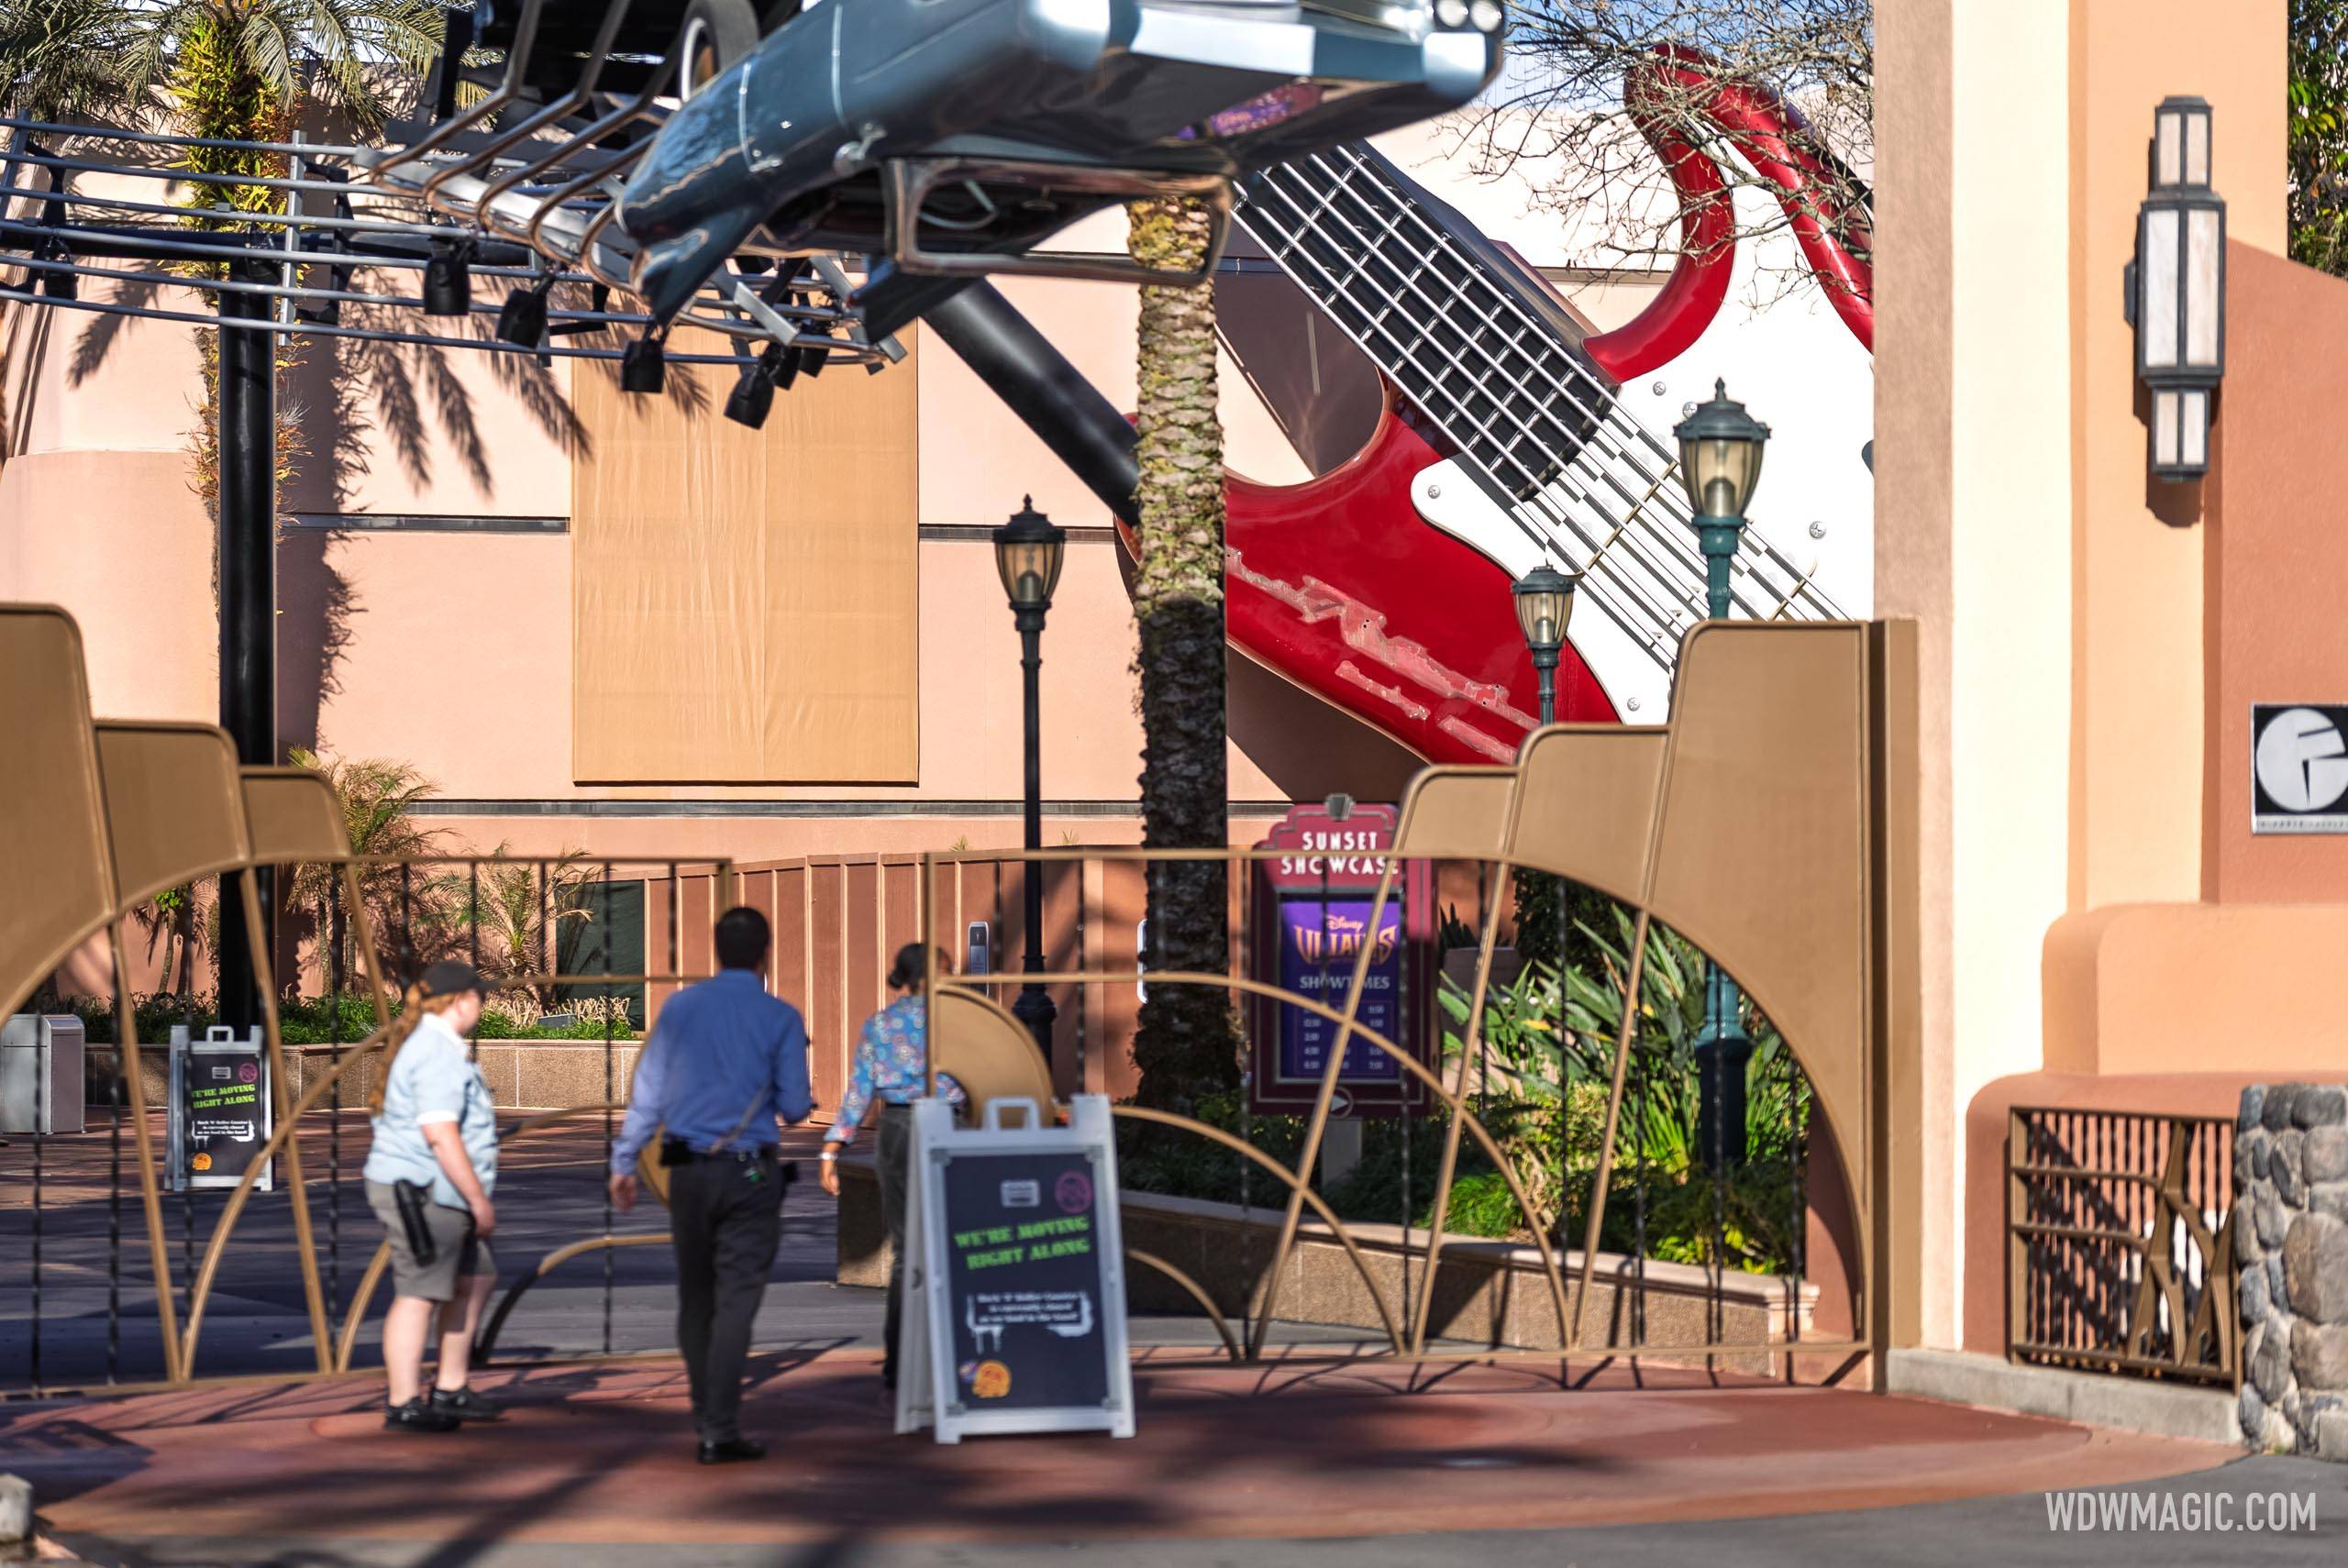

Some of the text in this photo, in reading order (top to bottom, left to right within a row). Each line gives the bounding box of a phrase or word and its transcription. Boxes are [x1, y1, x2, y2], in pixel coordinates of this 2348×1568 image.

[1302, 832, 1378, 851] SUNSET
[219, 1084, 255, 1095] MOVING
[224, 1094, 255, 1105] ALONG
[954, 1216, 1089, 1248] WE'RE MOVING
[967, 1238, 1091, 1270] RIGHT ALONG
